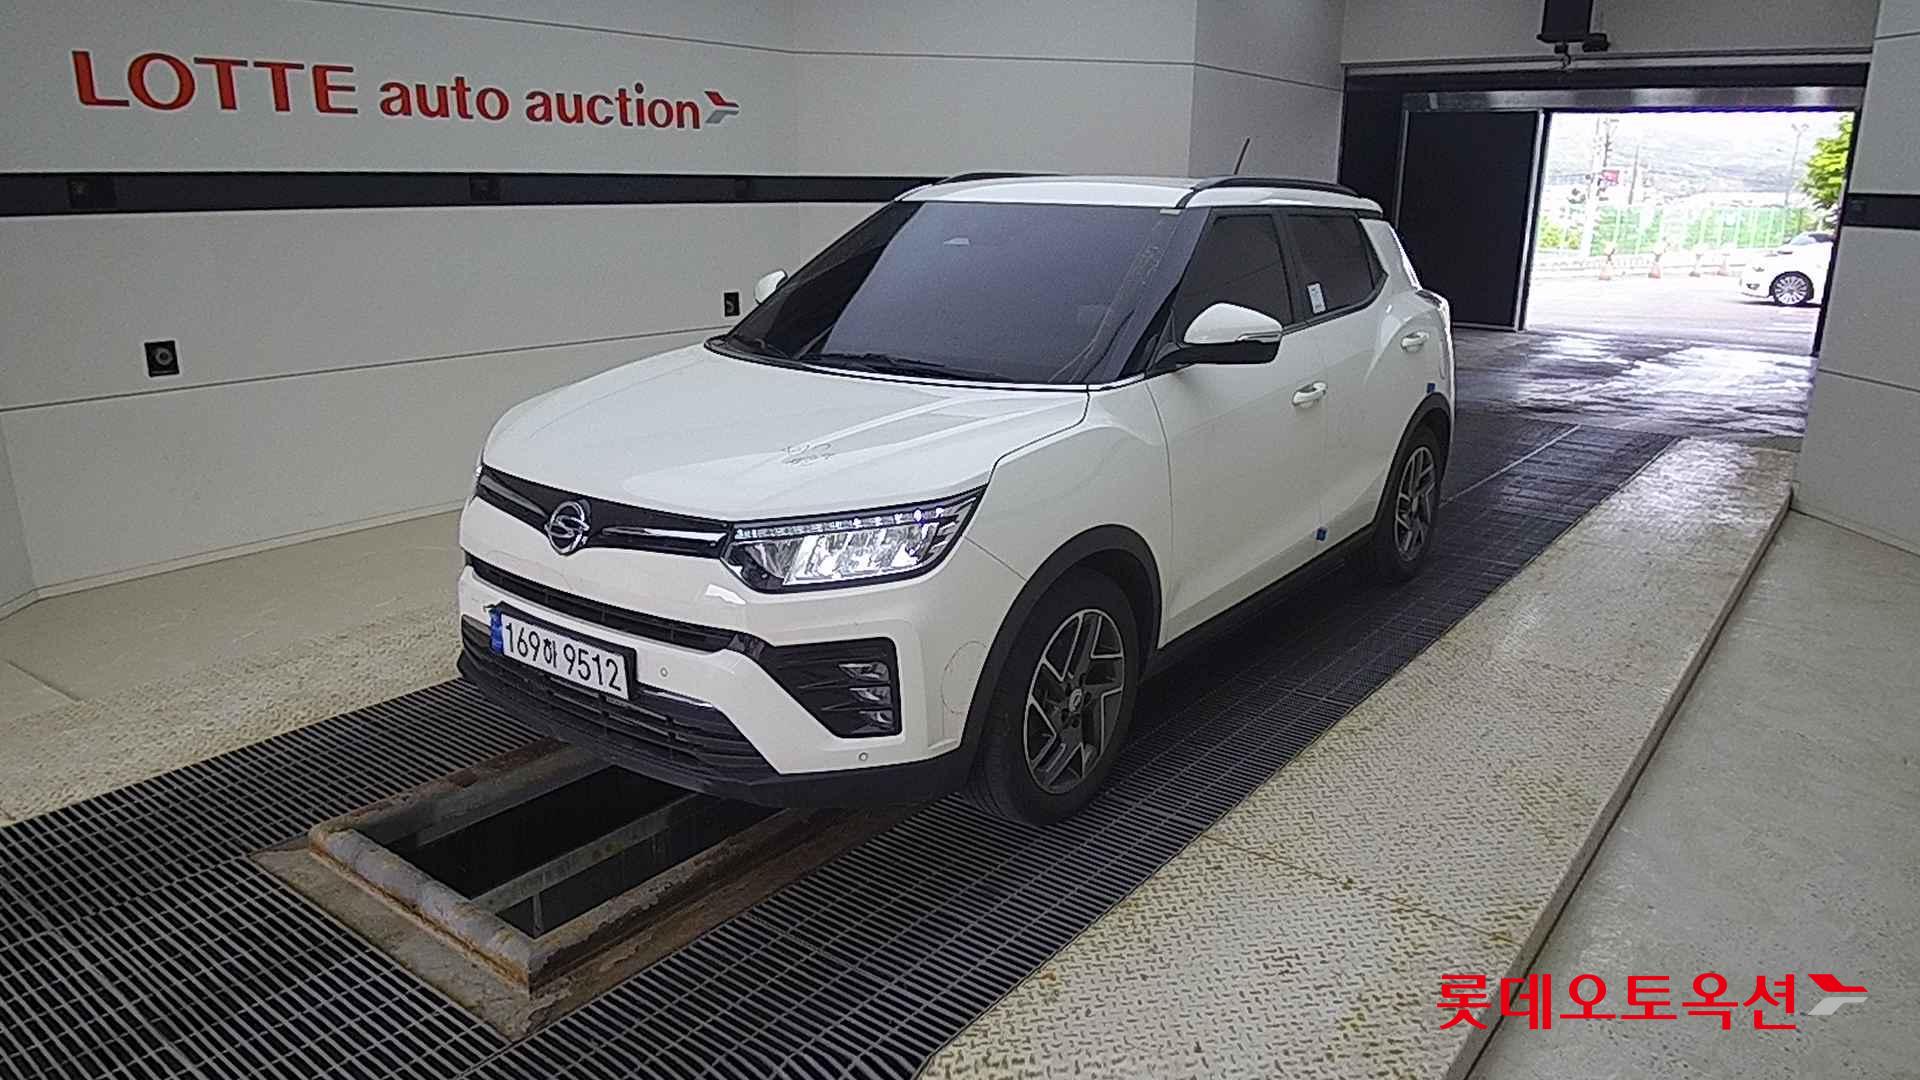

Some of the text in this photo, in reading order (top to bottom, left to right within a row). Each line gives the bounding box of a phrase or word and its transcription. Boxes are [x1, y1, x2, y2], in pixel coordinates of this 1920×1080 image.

[72, 50, 702, 130] LOTTE auto auction
[505, 622, 622, 692] 169하 9512
